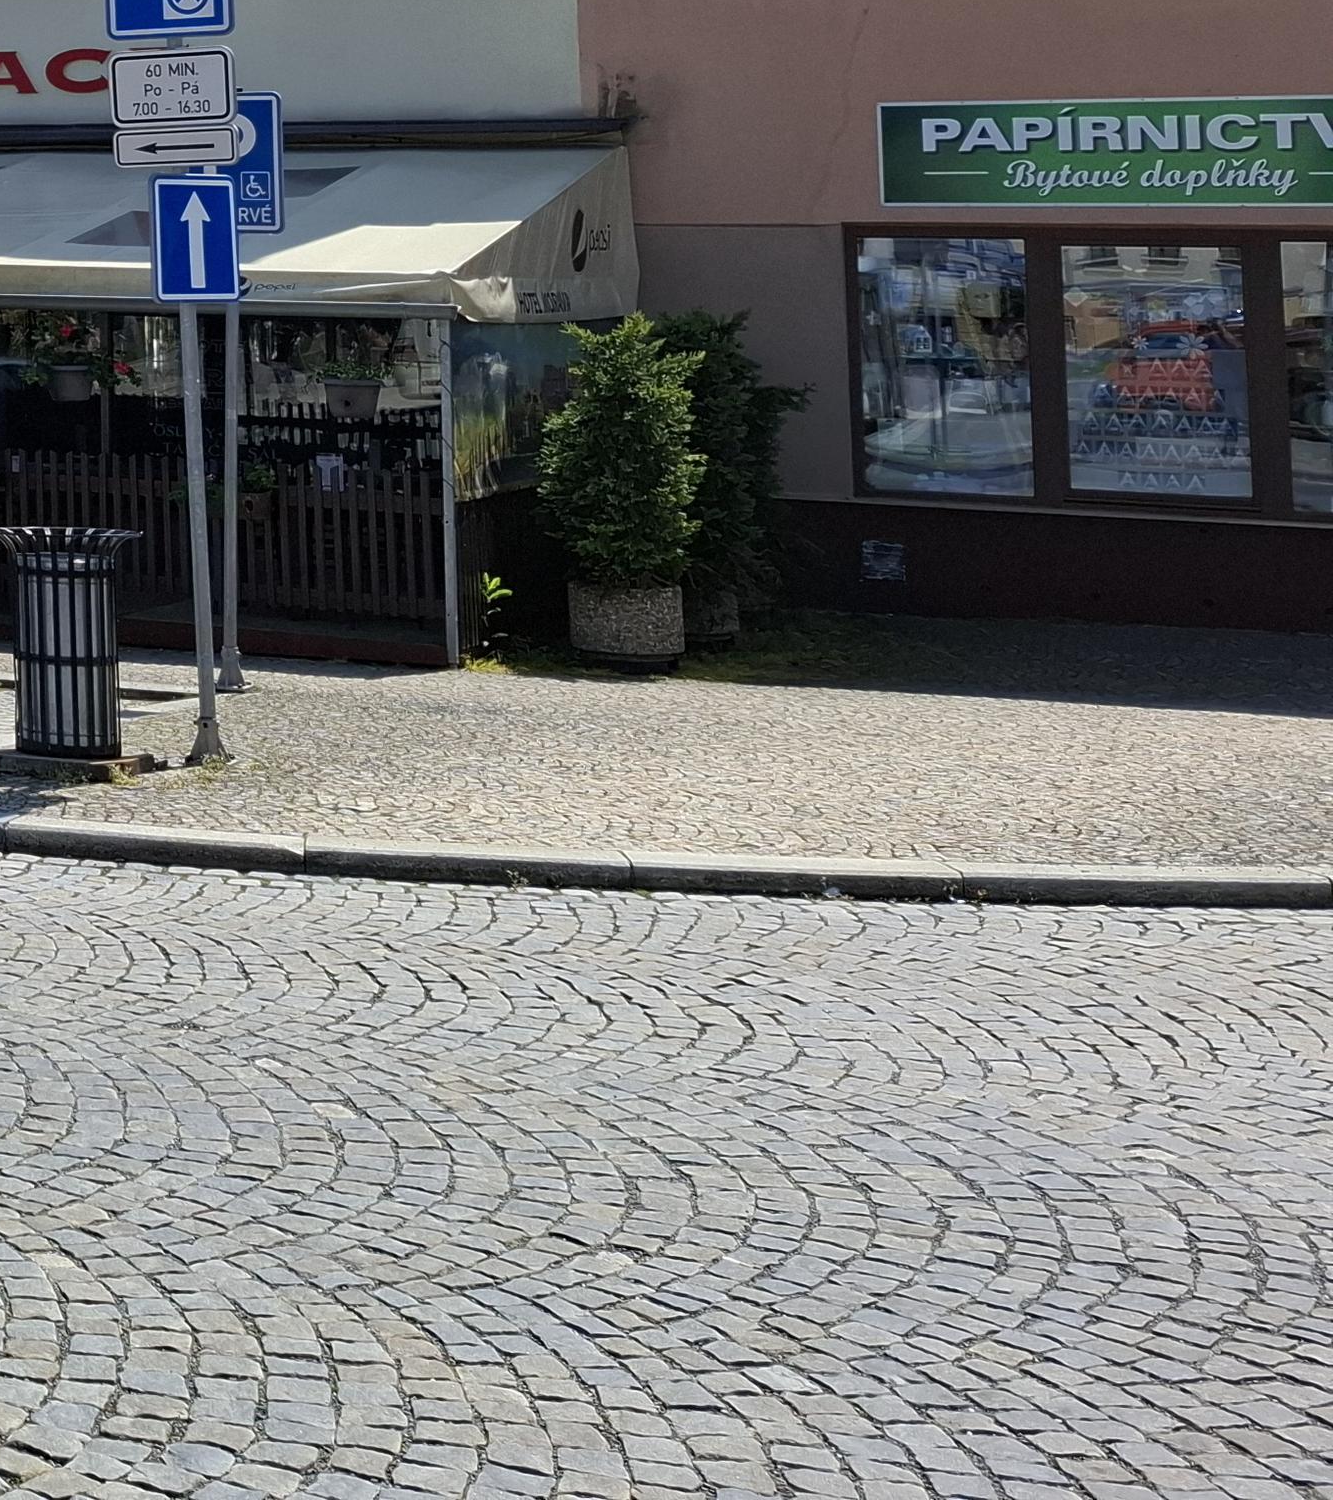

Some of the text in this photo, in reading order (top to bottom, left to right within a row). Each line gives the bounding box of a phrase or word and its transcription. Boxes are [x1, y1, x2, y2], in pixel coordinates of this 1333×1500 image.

[145, 62, 199, 78] 60 MIN.
[143, 83, 162, 97] Po
[181, 80, 200, 95] Pá
[133, 102, 158, 117] 7.00
[178, 100, 211, 115] 16.30
[1003, 157, 1299, 196] Bytové doplňky
[238, 203, 272, 224] RVÉ
[589, 223, 611, 259] pepsi
[253, 281, 297, 294] pepsi
[517, 291, 543, 314] HOTEL
